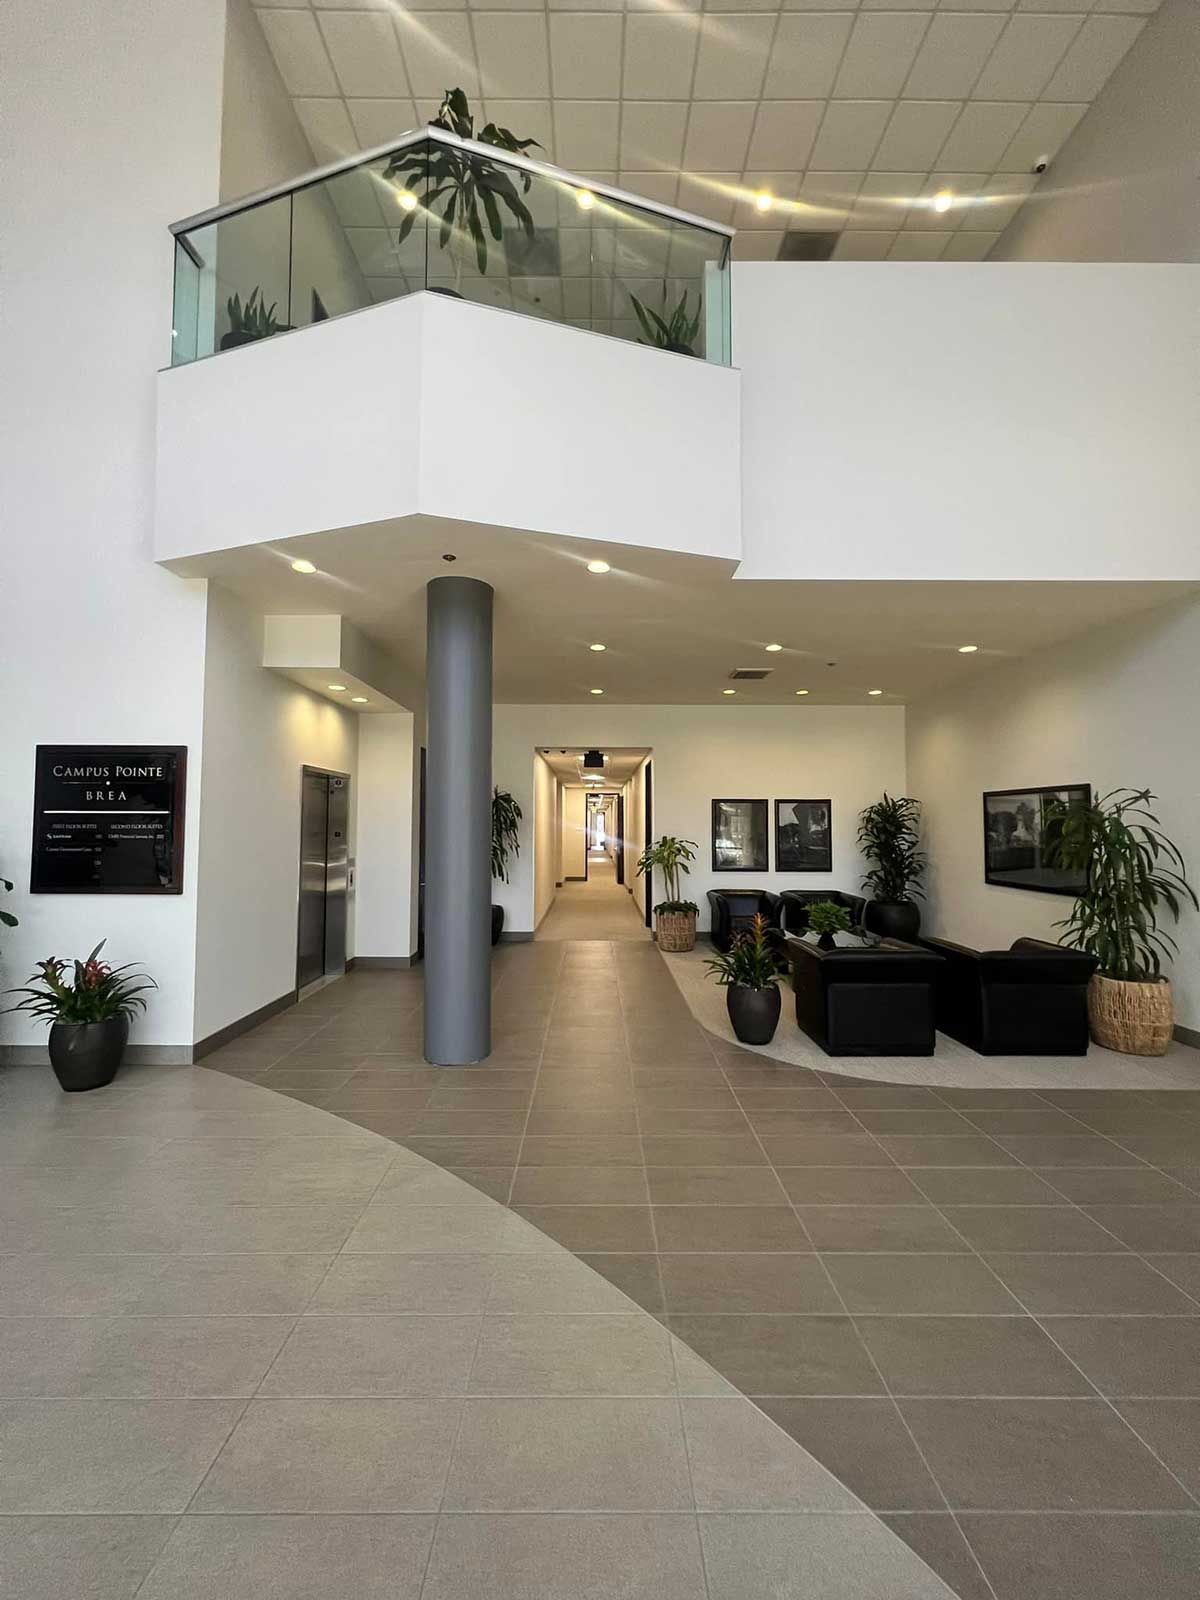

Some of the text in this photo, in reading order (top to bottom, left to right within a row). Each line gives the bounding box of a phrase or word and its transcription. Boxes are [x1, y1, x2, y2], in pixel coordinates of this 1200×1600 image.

[52, 765, 163, 777] CAMPUS POINTE
[86, 790, 127, 801] BREA
